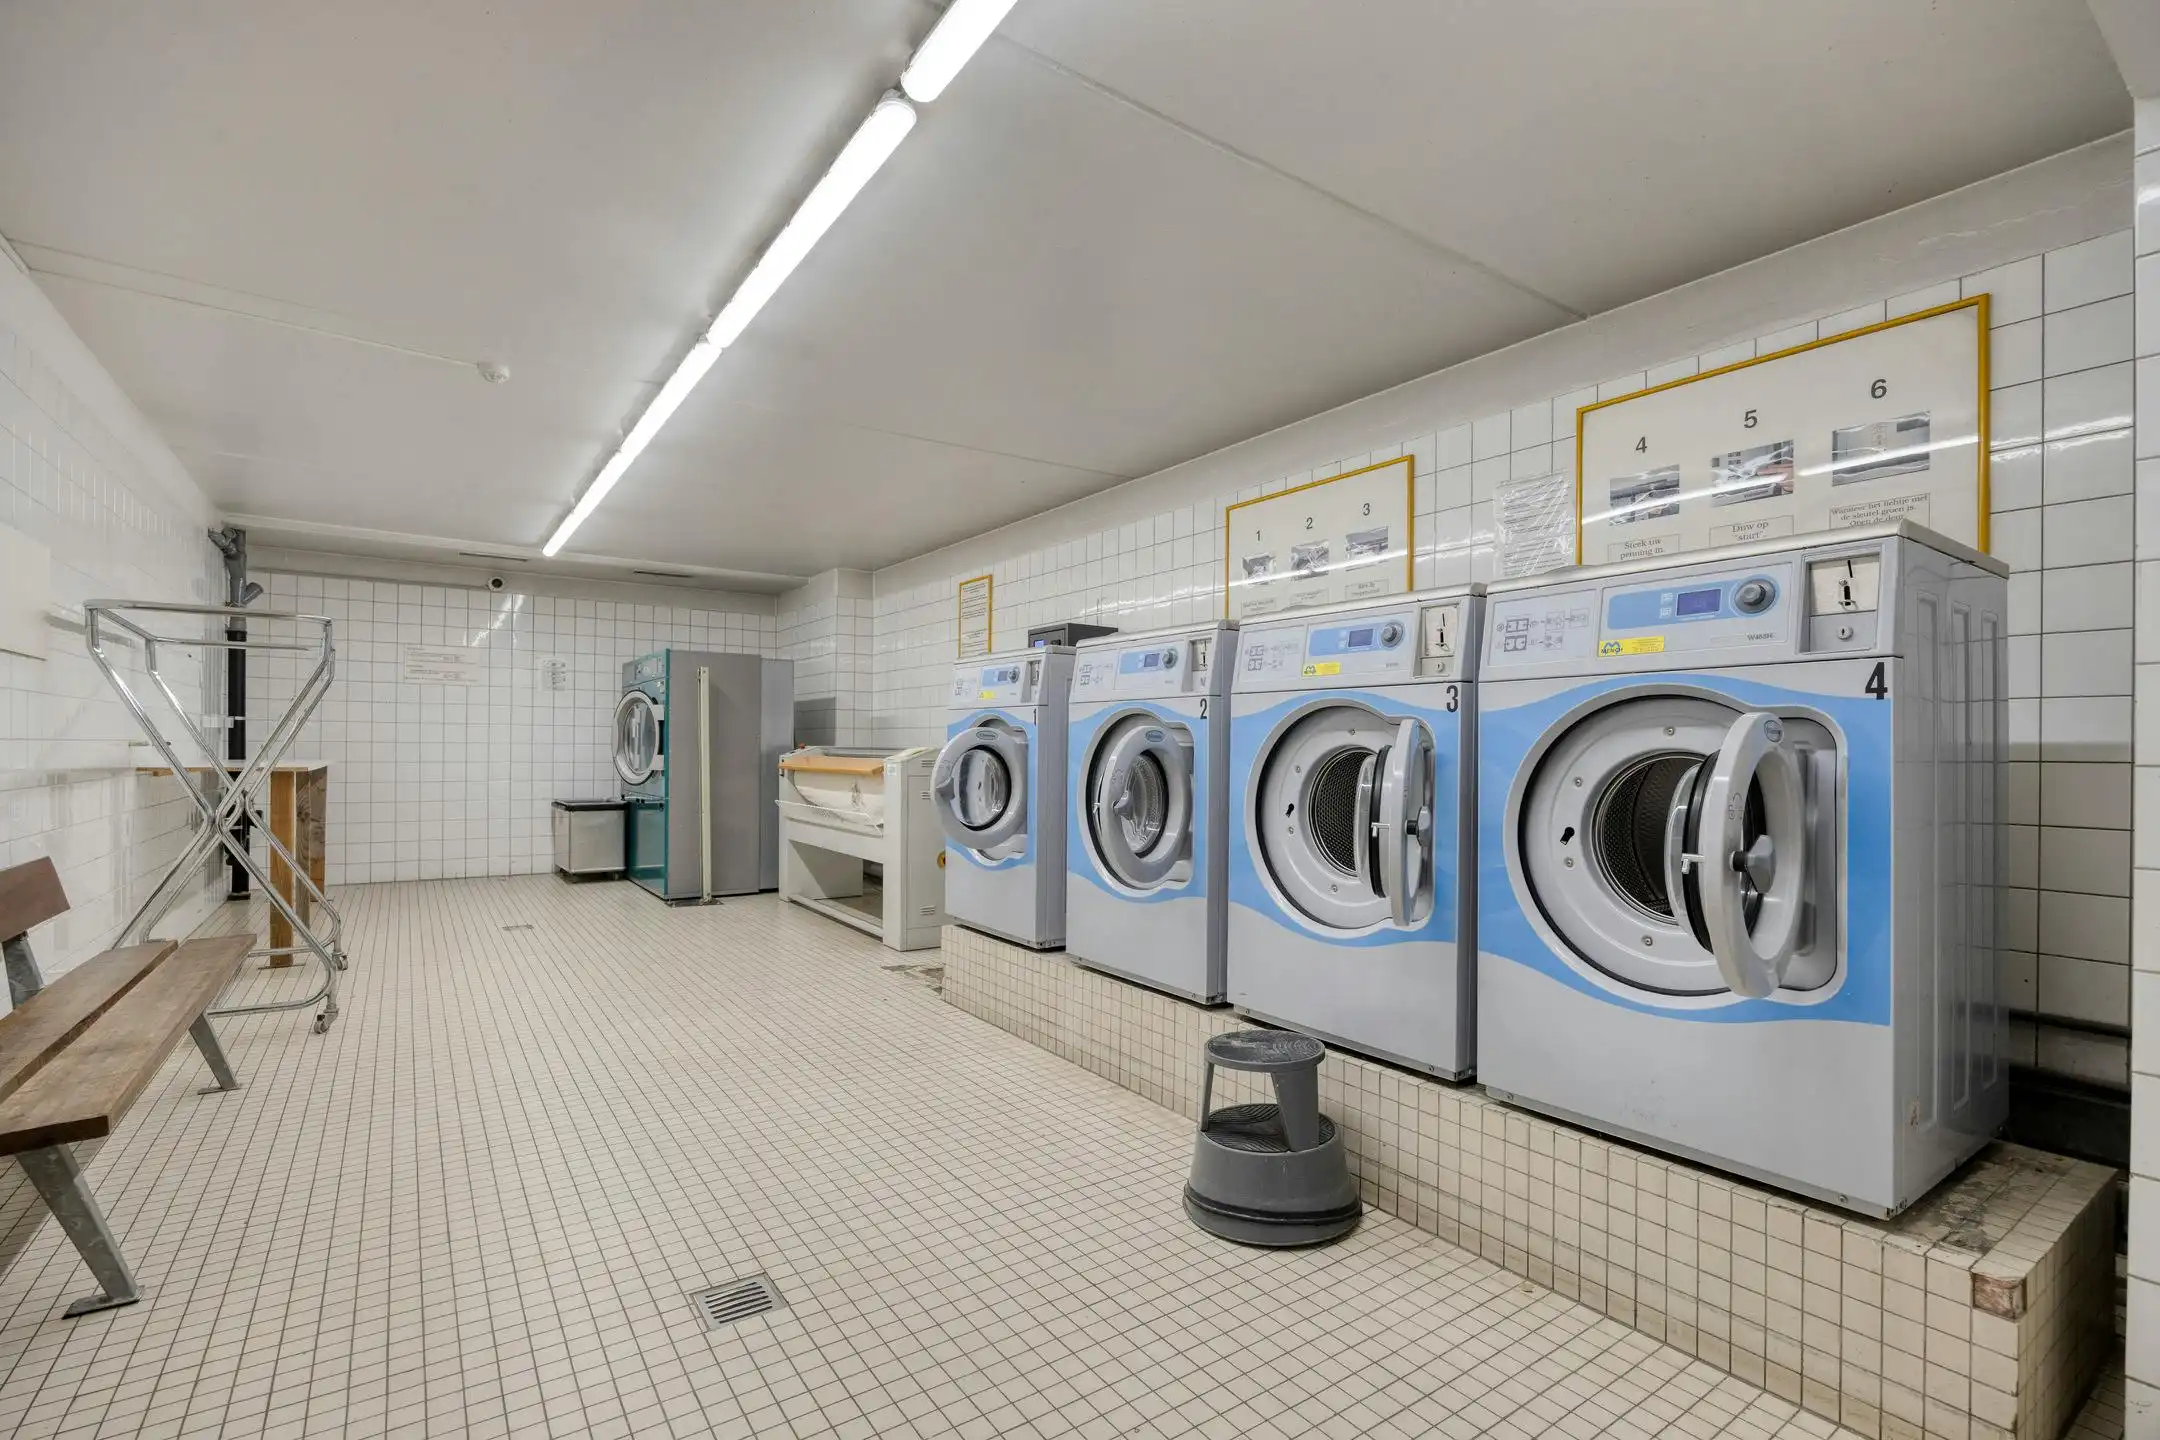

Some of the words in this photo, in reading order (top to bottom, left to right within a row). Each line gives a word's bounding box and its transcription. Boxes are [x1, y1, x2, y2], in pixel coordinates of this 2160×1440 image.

[1870, 379, 1887, 399] 6
[1744, 409, 1758, 428] 5
[1635, 436, 1648, 453] 4
[1363, 503, 1371, 516] 3
[1306, 517, 1313, 530] 2
[1757, 521, 1769, 529] op
[1256, 530, 1261, 542] 1
[1865, 661, 1888, 700] 4
[1446, 685, 1459, 713] 3
[1033, 708, 1038, 727] 1
[1200, 698, 1208, 720] 2
